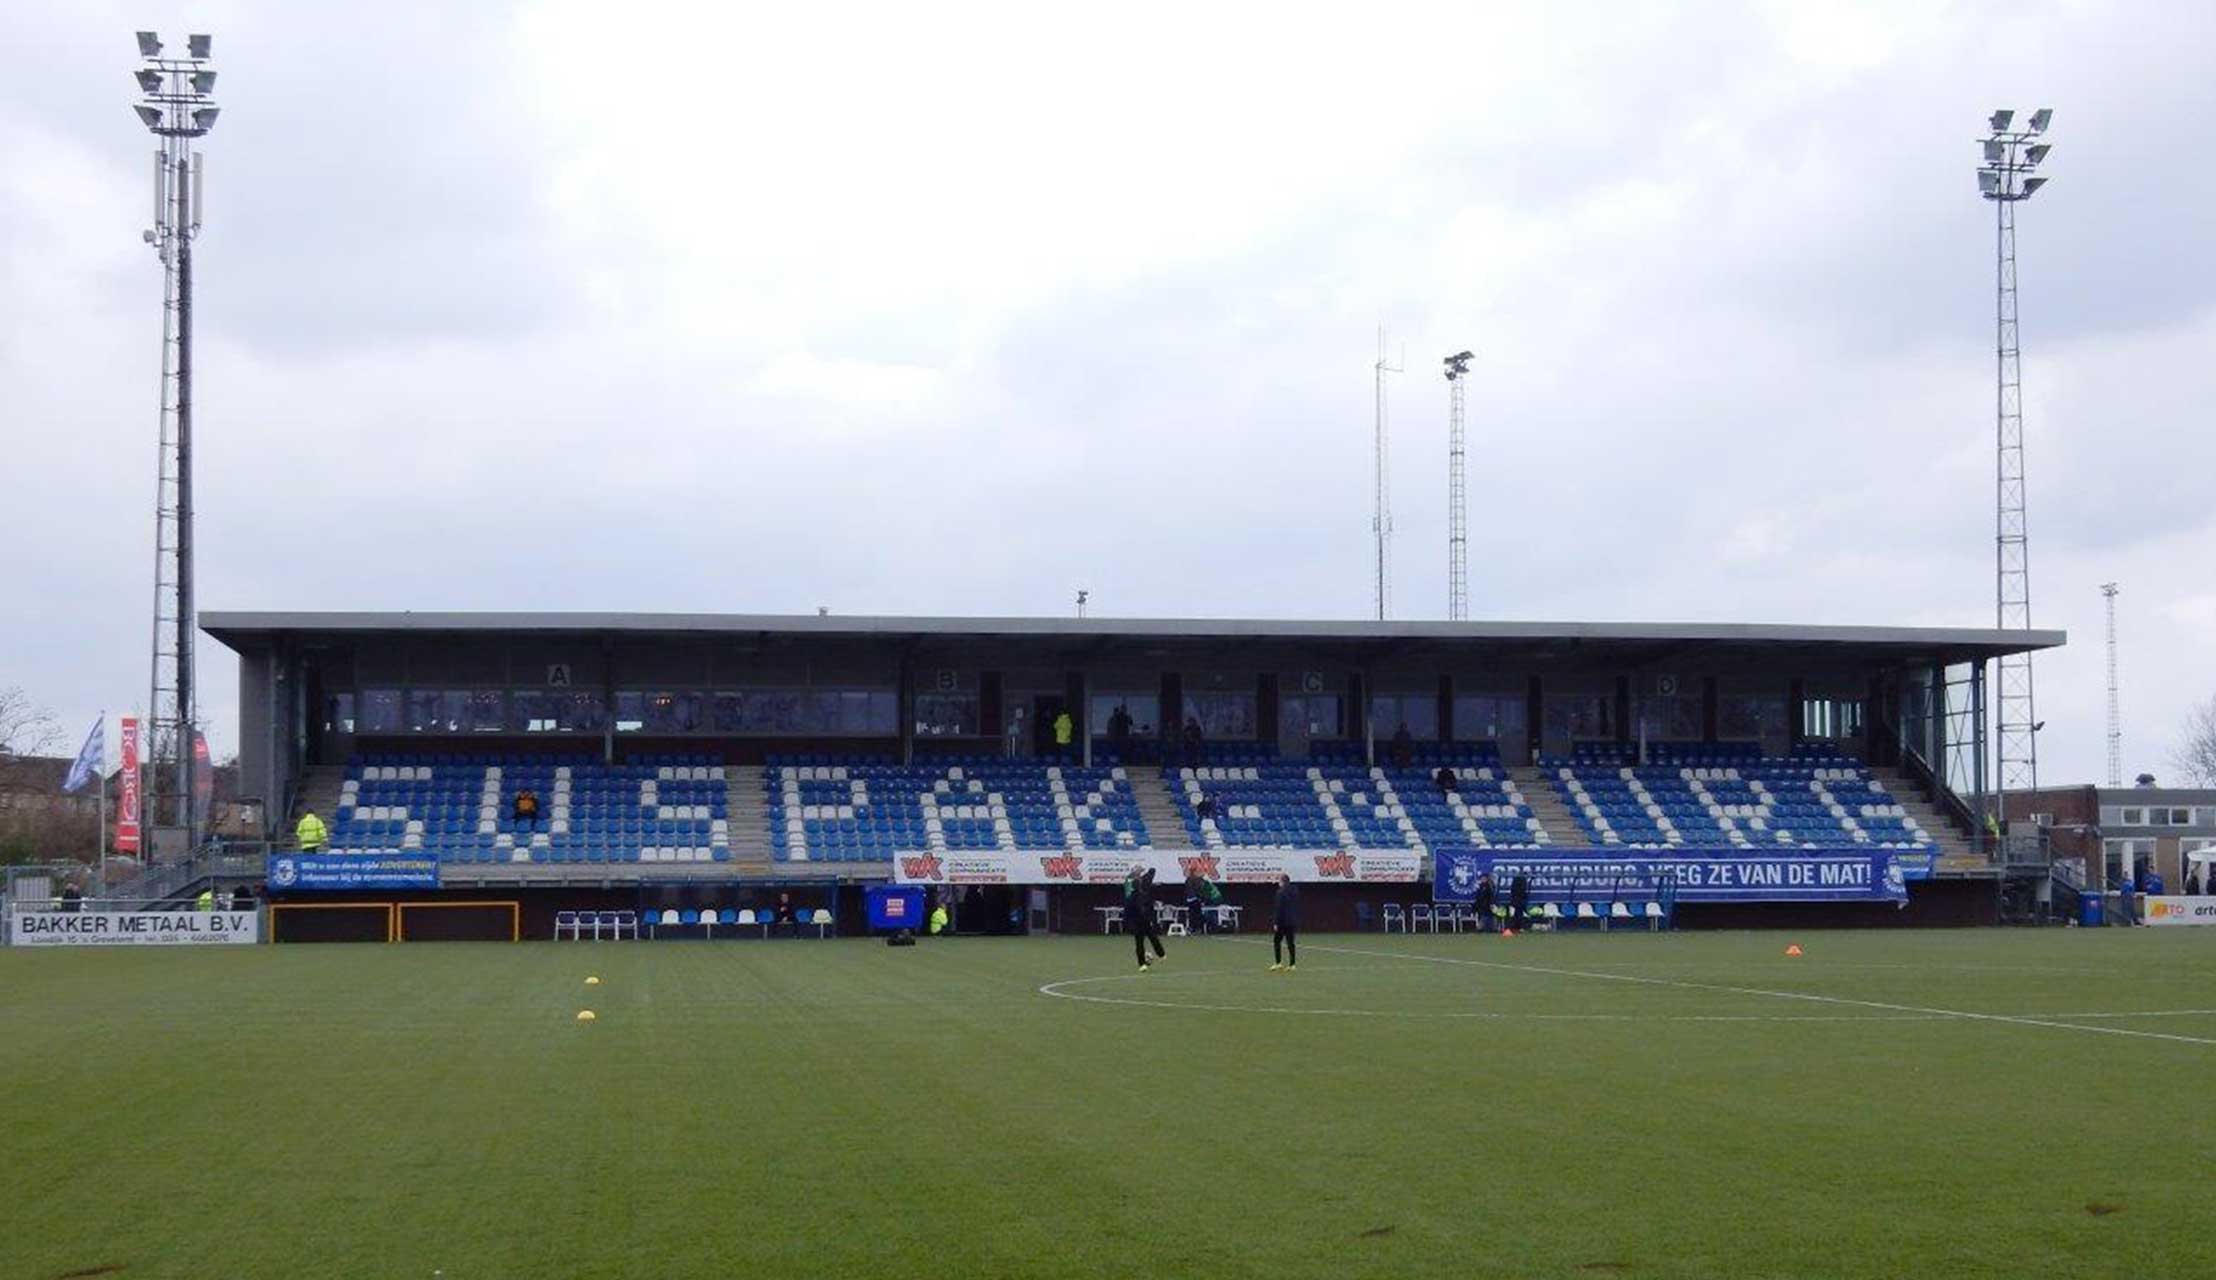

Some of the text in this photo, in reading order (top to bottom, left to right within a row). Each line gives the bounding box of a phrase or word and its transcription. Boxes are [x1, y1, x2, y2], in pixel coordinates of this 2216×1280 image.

[551, 666, 568, 684] A
[1707, 864, 1733, 885] ZE
[1738, 864, 1782, 885] VAN
[1788, 864, 1815, 885] DE
[1820, 863, 1872, 884] MAT!
[22, 915, 248, 934] BAKKER METAAL B.V.
